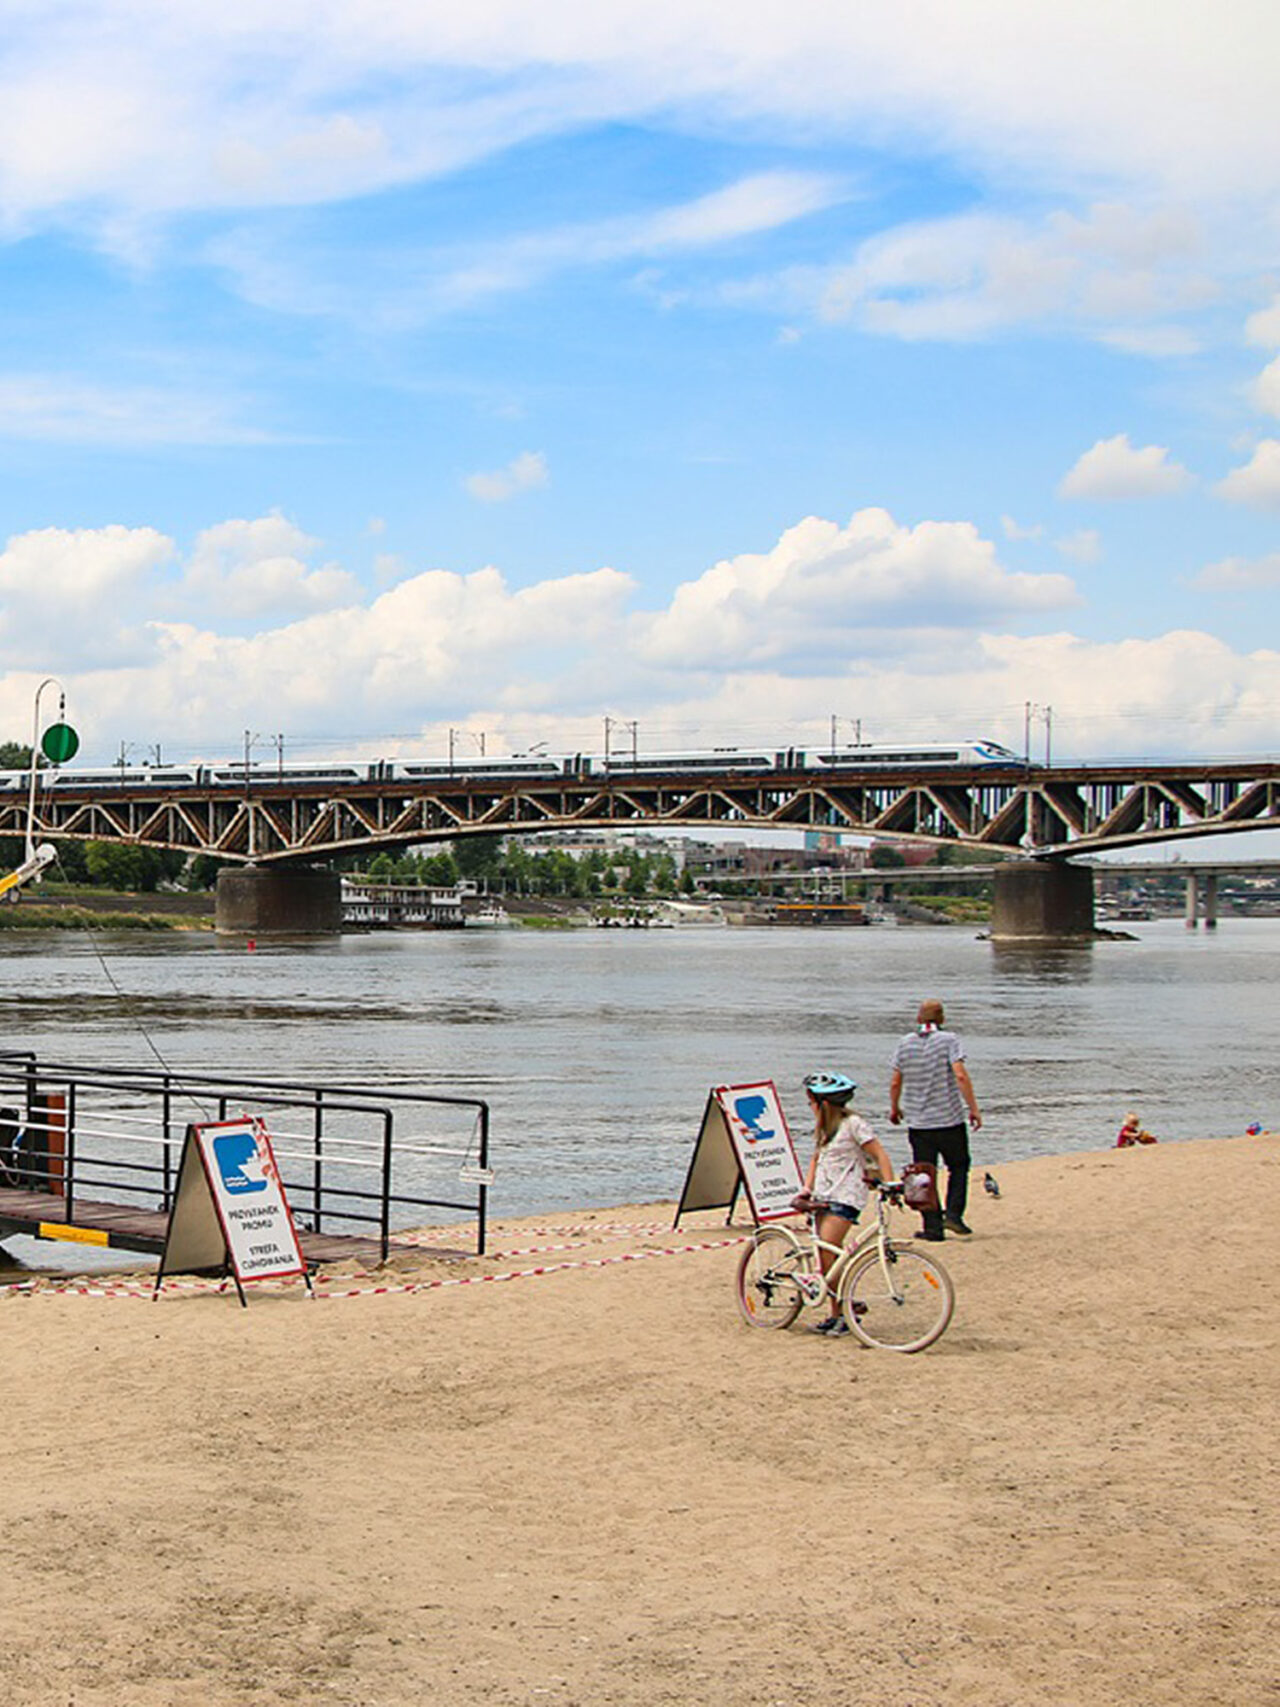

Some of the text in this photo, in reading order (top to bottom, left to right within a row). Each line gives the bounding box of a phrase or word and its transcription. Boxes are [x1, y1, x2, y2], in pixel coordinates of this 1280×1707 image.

[228, 1205, 279, 1220] PRZYSTANEK
[241, 1219, 273, 1230] PROMU
[249, 1243, 279, 1255] STREFA
[242, 1254, 294, 1270] CUMOWANIA
